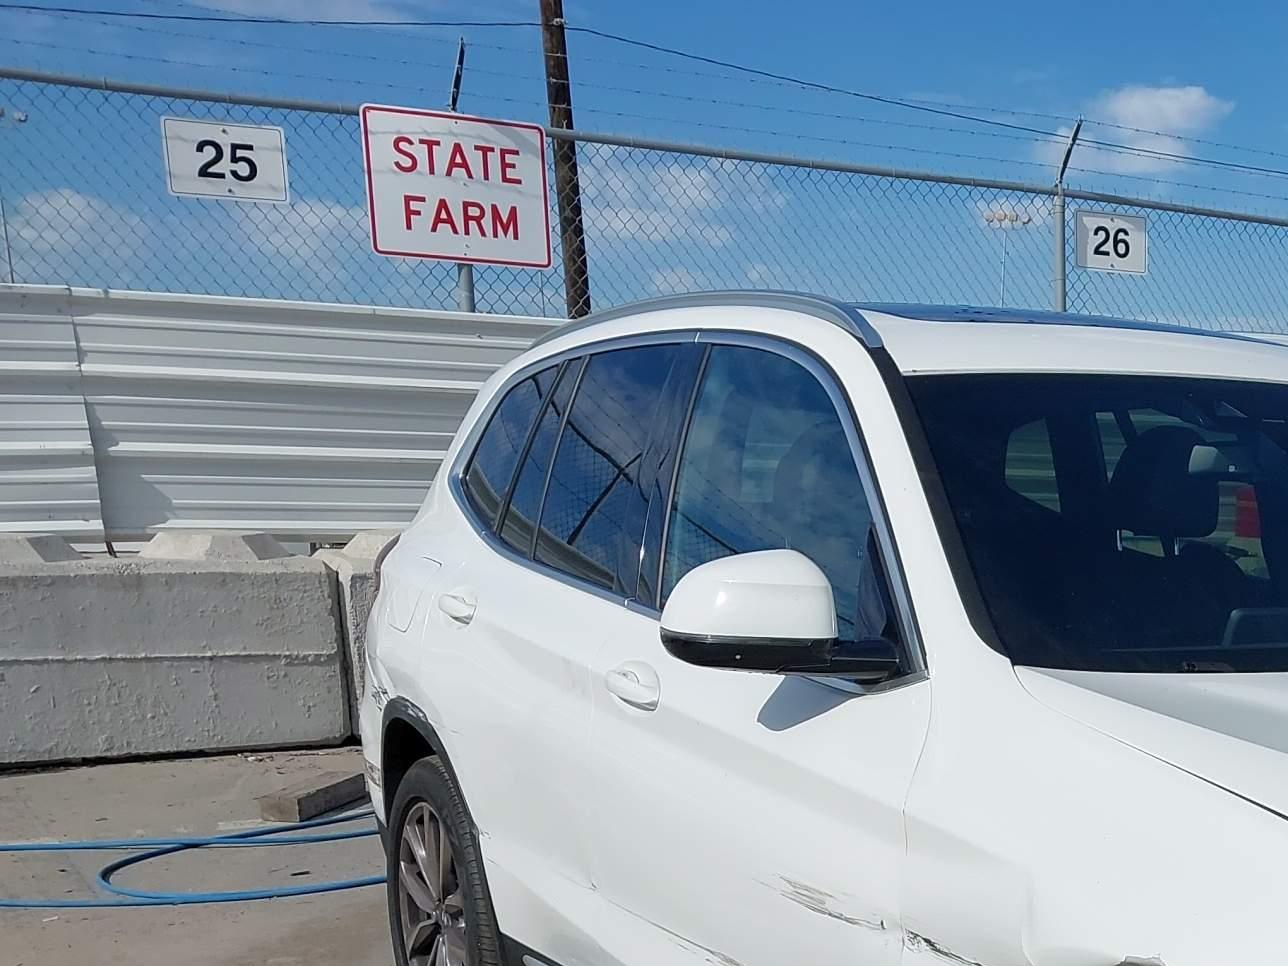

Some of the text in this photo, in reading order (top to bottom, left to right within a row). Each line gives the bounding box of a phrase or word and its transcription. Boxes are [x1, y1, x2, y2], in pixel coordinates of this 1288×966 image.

[195, 139, 258, 183] 25
[394, 136, 523, 185] STATE
[403, 194, 519, 241] FARM
[1093, 225, 1130, 259] 26
